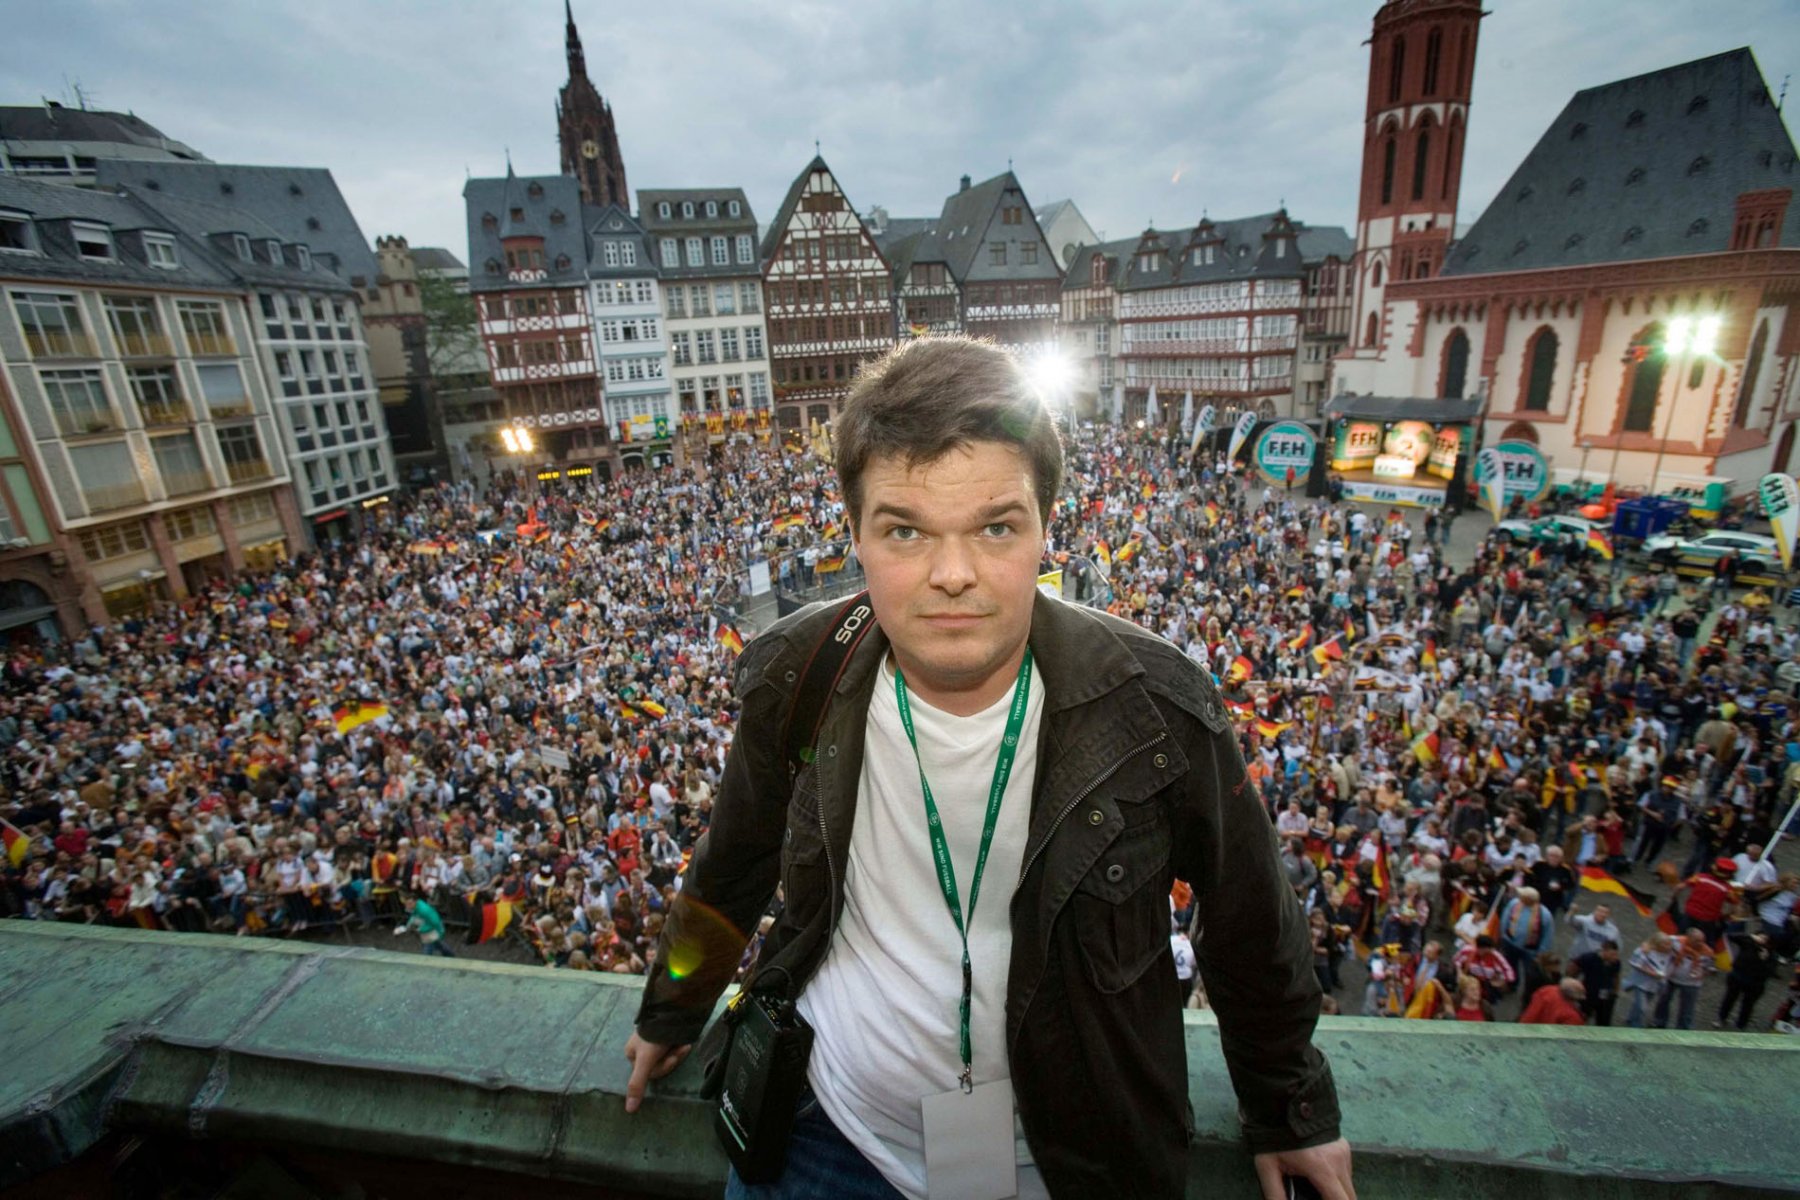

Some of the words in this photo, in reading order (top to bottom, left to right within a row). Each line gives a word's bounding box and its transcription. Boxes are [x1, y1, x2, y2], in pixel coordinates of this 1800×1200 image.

[1269, 441, 1306, 456] FFH
[1351, 432, 1378, 446] FFH
[1503, 461, 1535, 478] FH
[834, 605, 871, 644] EOS
[1013, 690, 1025, 721] FUSSBALL
[991, 784, 1001, 814] FUSSBALL
[938, 850, 946, 865] SIND
[941, 864, 953, 894] FUSSBALL
